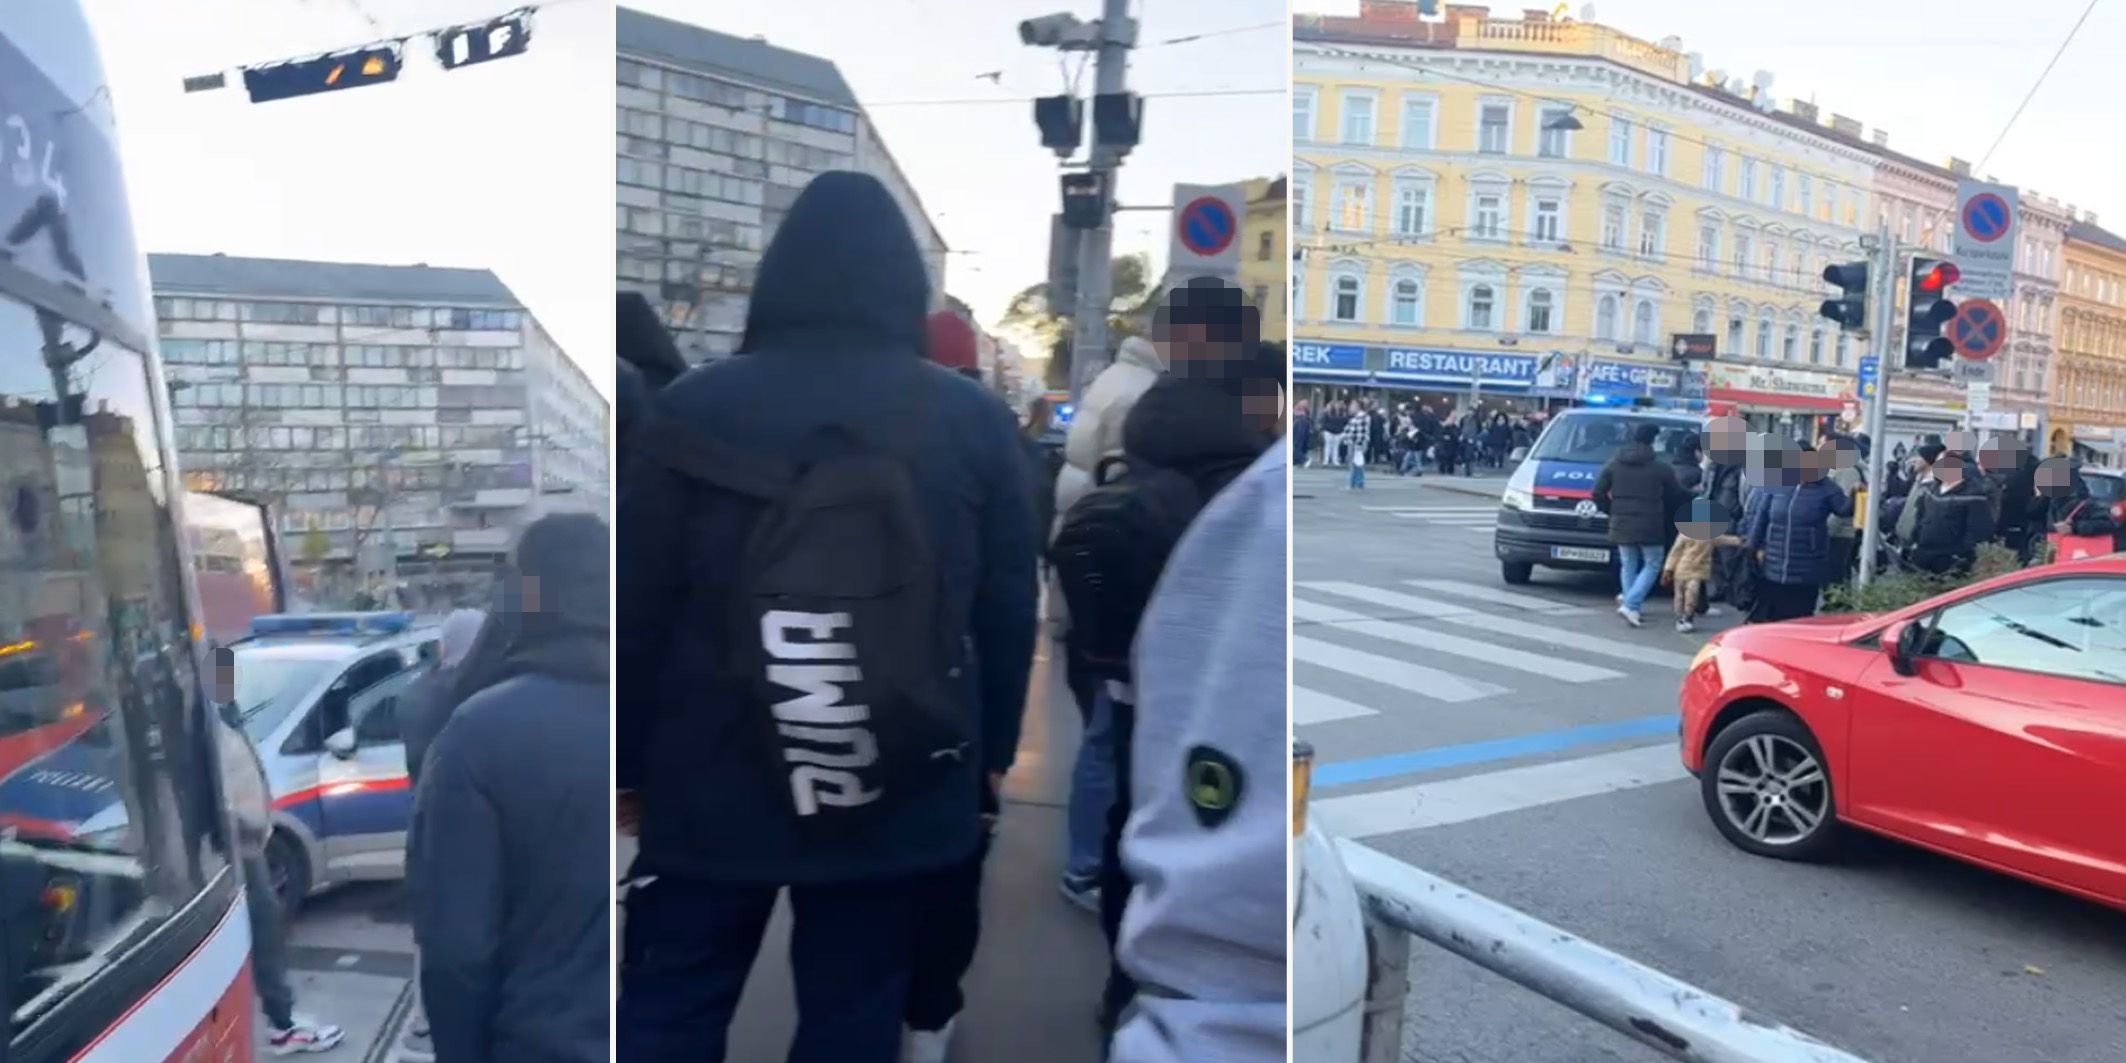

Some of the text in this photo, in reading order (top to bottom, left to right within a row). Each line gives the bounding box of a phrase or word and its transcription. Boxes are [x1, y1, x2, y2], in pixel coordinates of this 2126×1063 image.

[1390, 351, 1532, 376] RESTAURANT
[1582, 364, 1620, 382] AFÉ
[760, 610, 884, 815] PUMA
